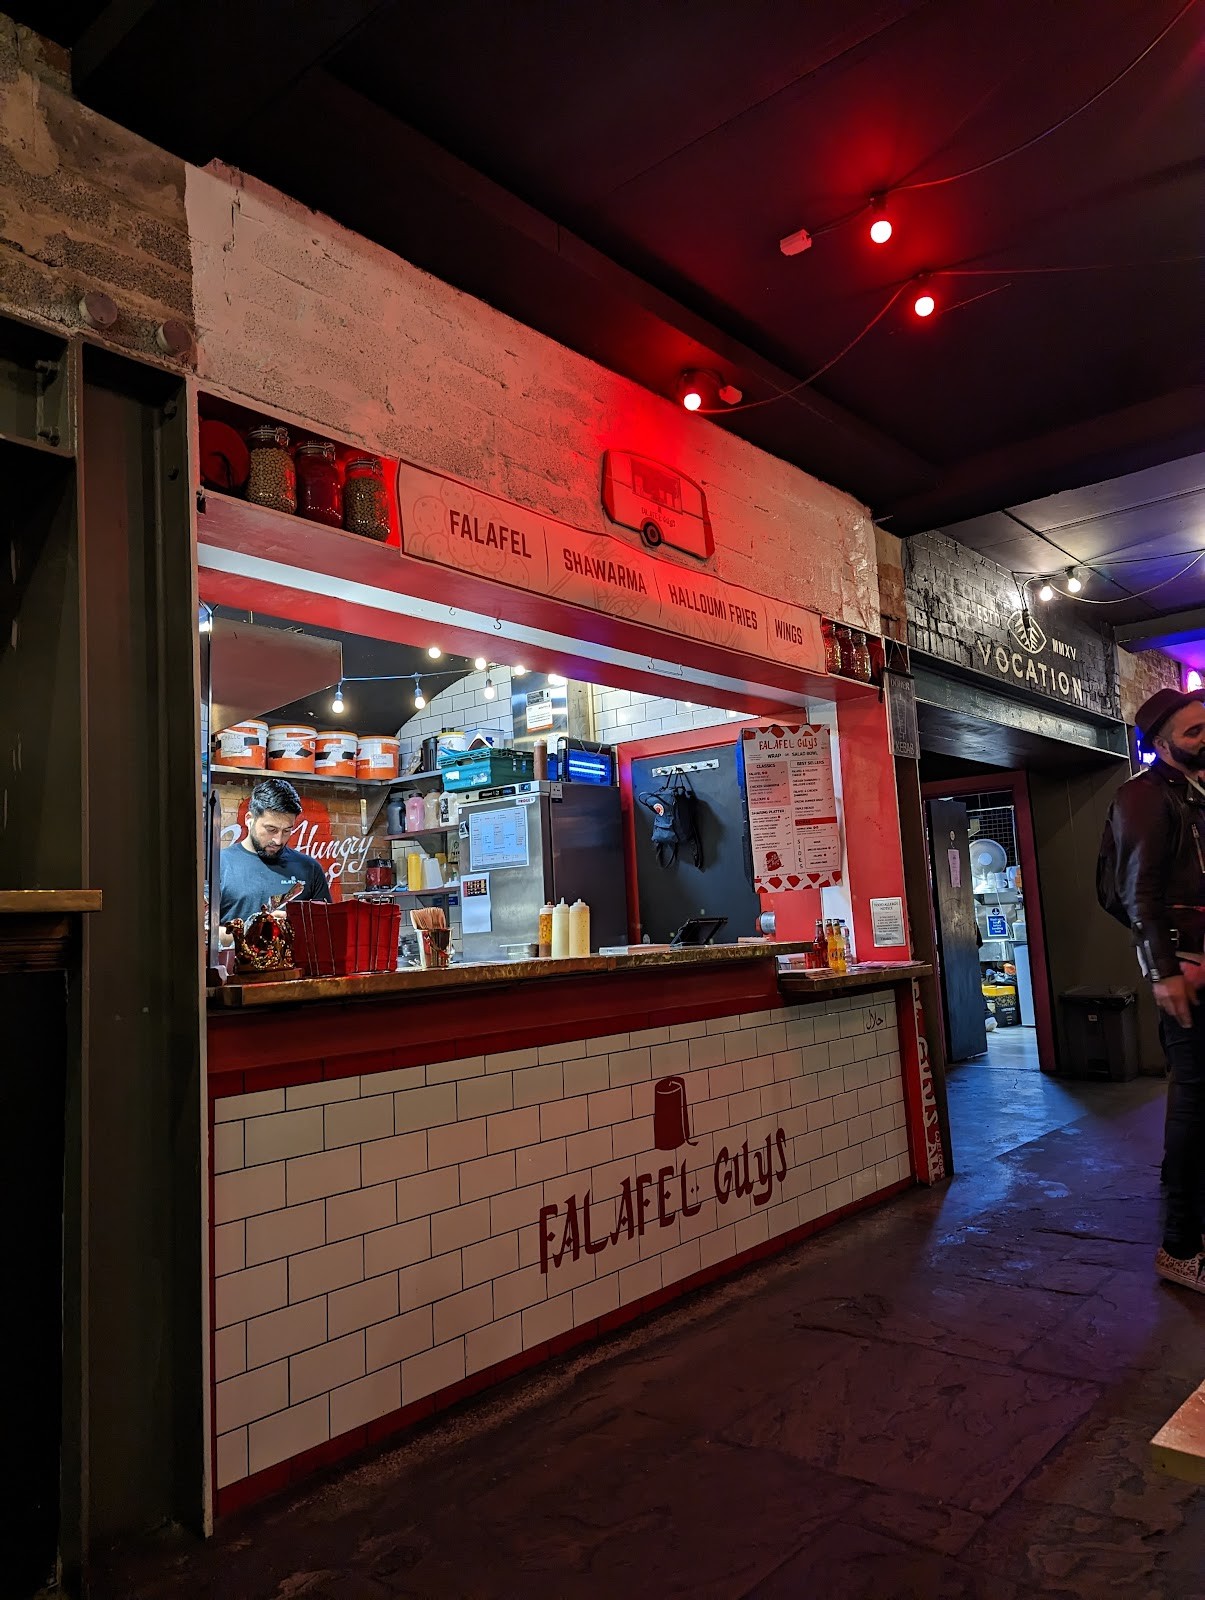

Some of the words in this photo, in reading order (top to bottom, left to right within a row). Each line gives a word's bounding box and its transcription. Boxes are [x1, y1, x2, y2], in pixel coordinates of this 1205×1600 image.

[449, 509, 532, 559] FALAFEL
[562, 548, 647, 595] SHAWARMA
[667, 583, 727, 622] HALLOUMI
[728, 599, 758, 631] FRIES
[774, 617, 804, 646] WINGS
[1052, 638, 1076, 661] MMXV
[976, 639, 1083, 702] VOCATION
[759, 738, 795, 751] FALAFEL
[895, 740, 915, 755] KEBAB
[539, 1158, 703, 1275] FALAFEL
